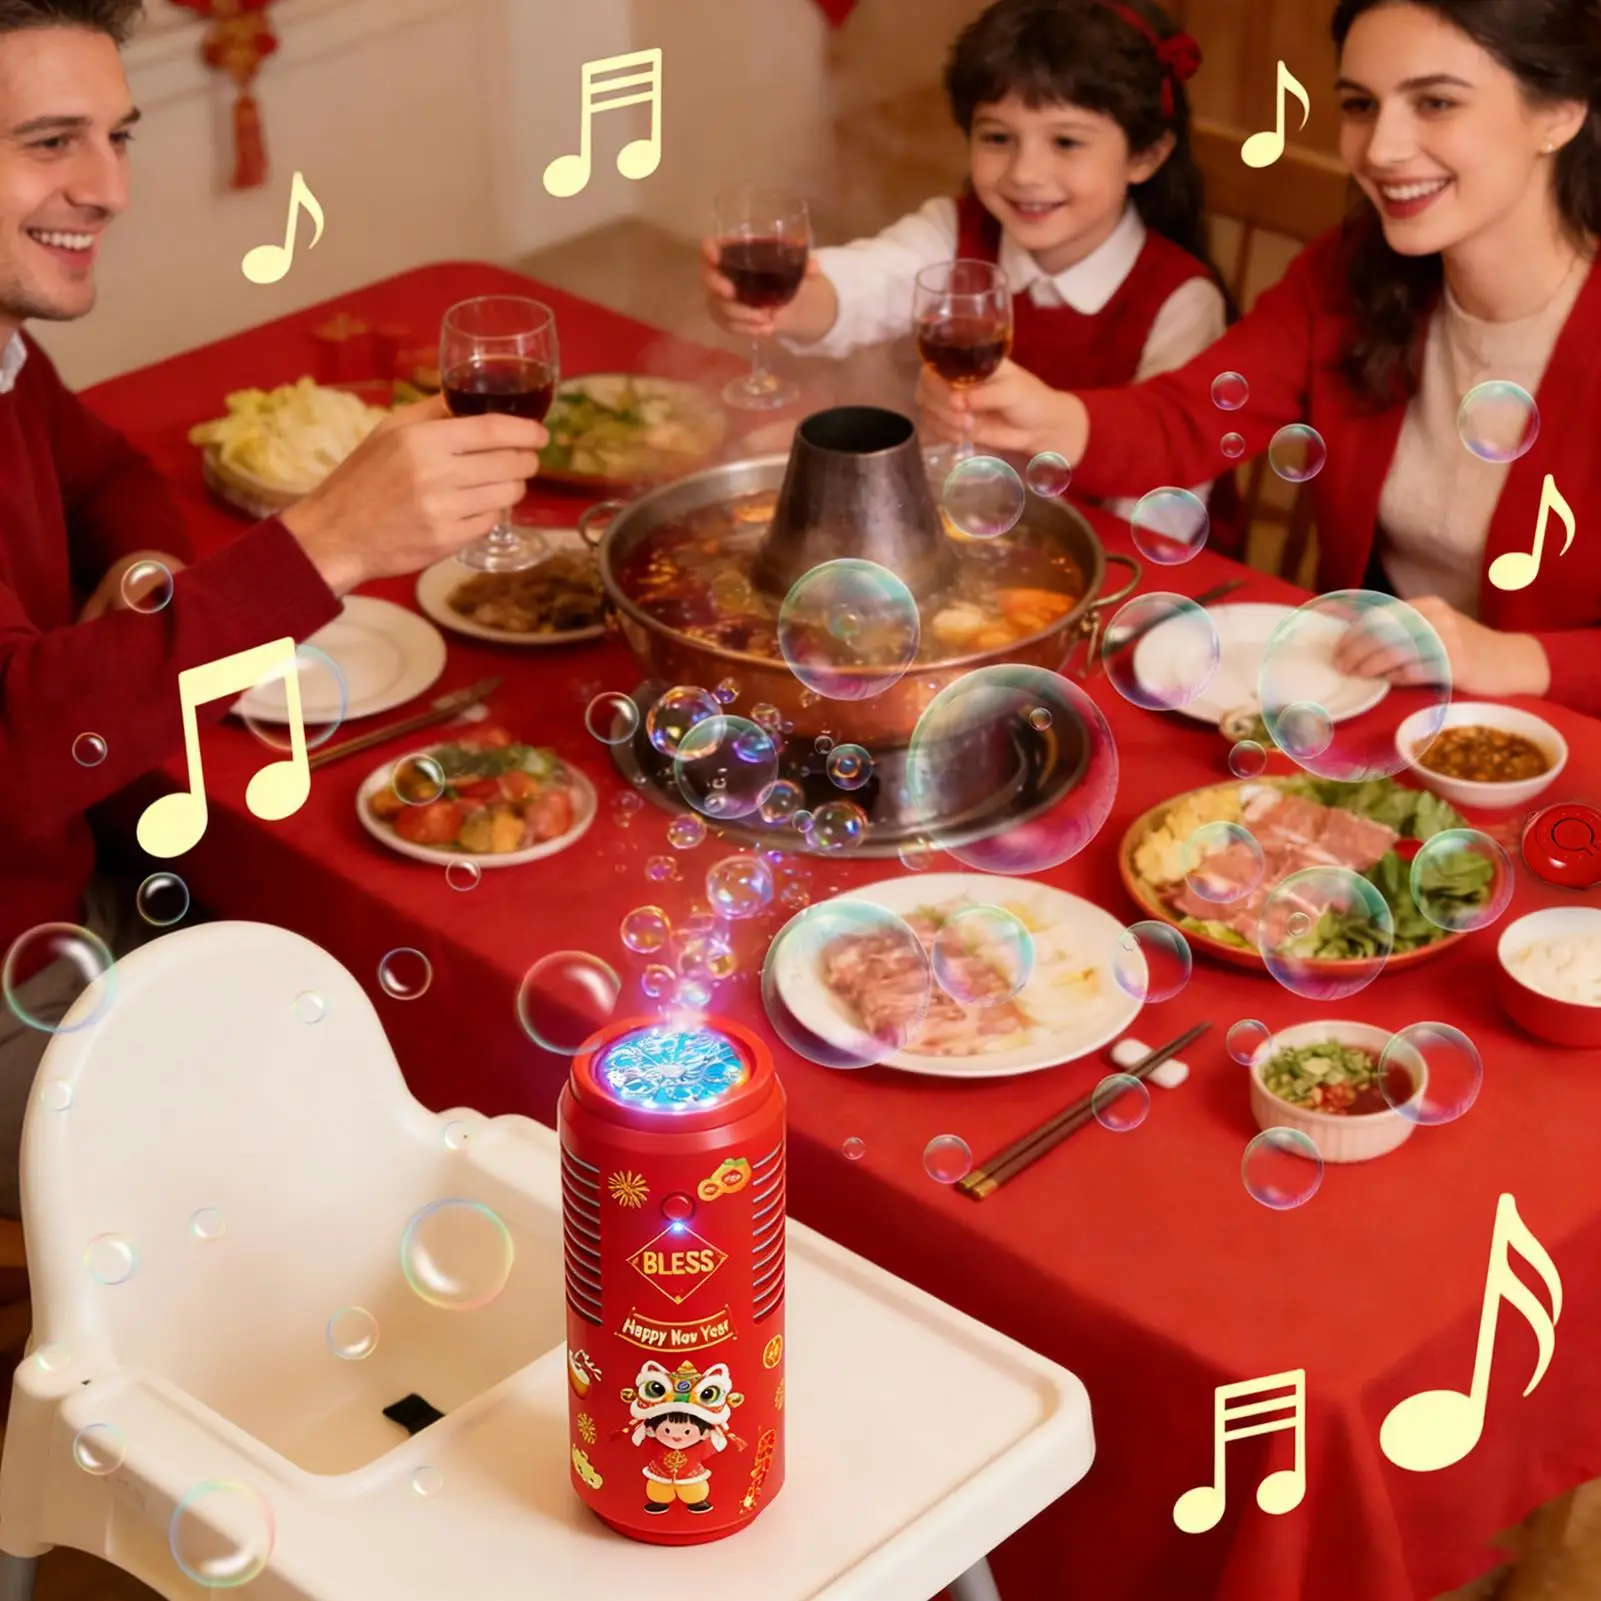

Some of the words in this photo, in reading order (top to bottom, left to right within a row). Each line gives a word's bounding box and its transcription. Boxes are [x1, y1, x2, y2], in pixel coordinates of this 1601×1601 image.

[643, 1249, 714, 1275] BLESS
[622, 1318, 667, 1346] Happy
[700, 1319, 729, 1342] Year
